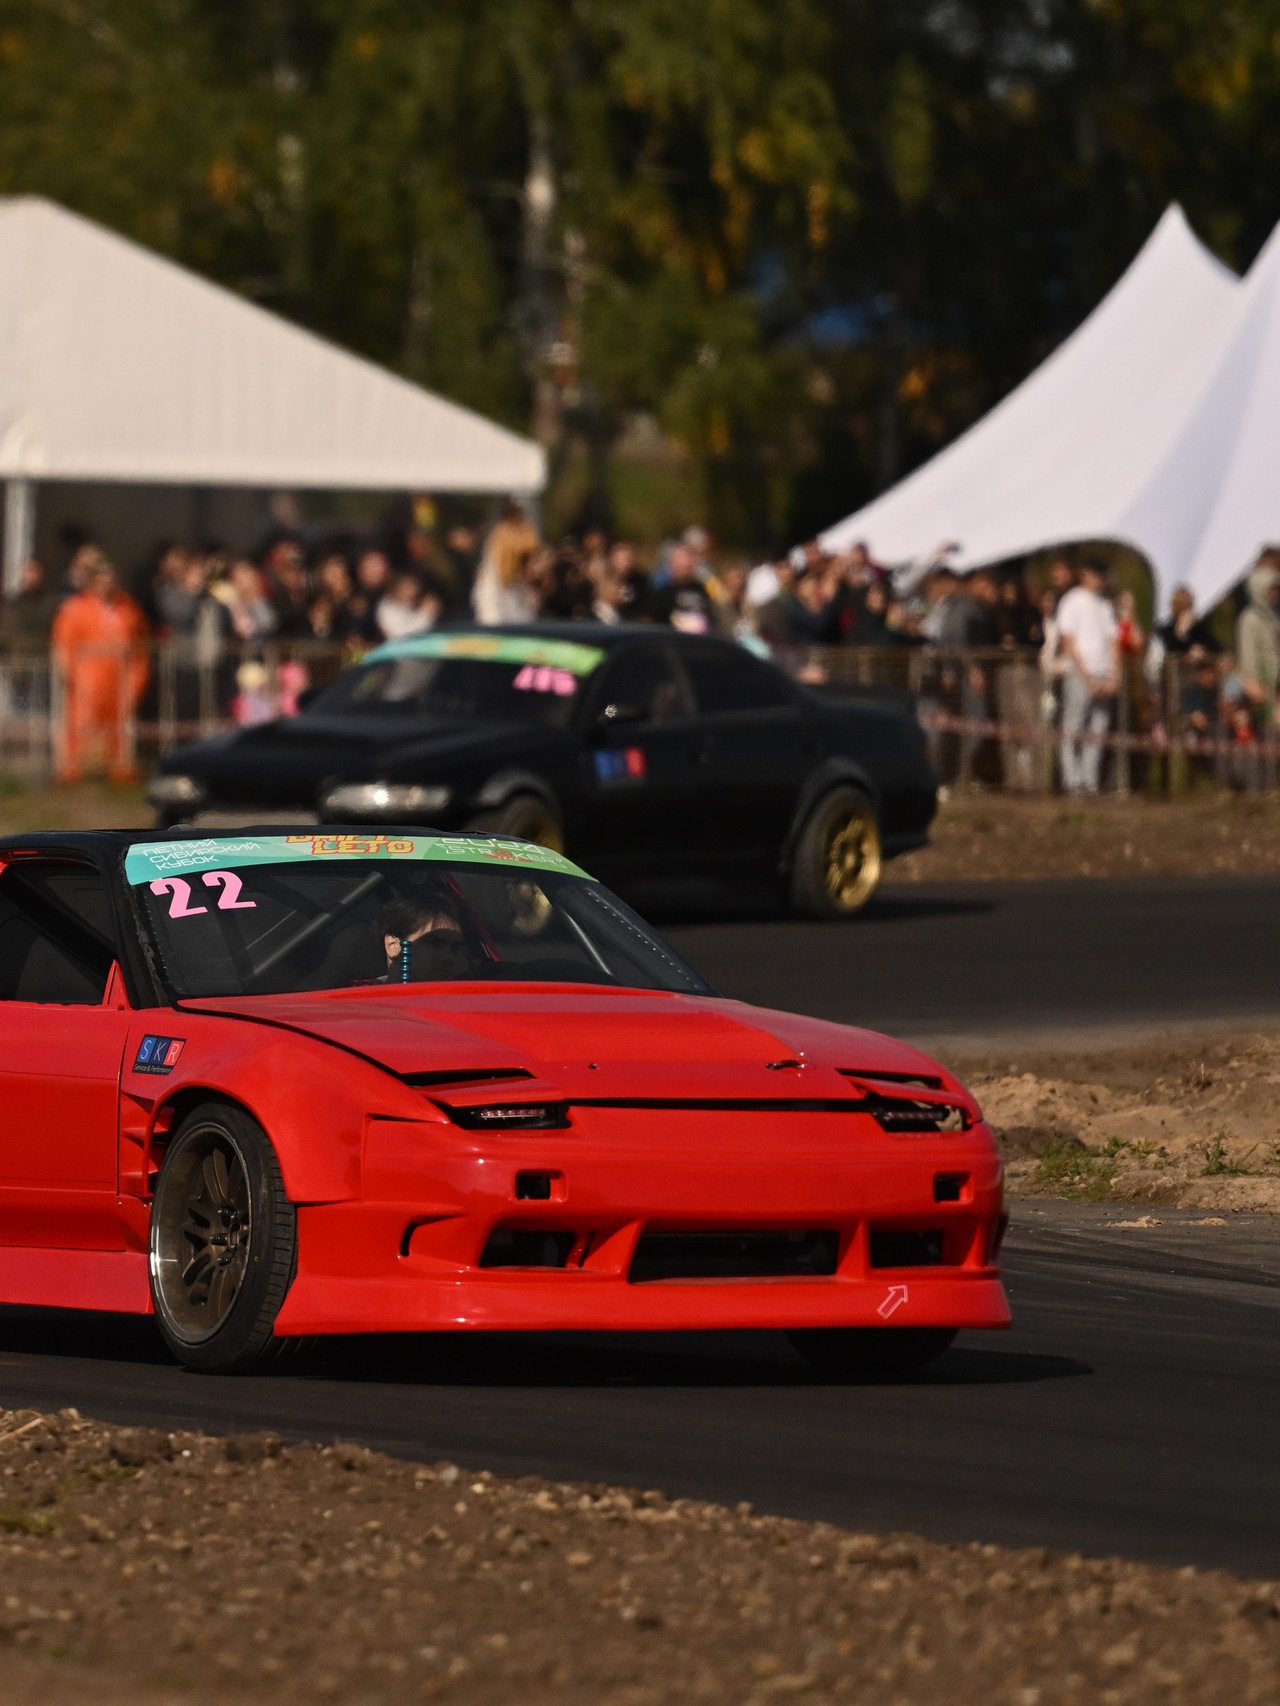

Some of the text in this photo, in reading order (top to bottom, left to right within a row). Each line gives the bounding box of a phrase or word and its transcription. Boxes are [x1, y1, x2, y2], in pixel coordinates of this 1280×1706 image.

[142, 839, 218, 857] ЛЕТНИЙ
[149, 842, 261, 863] СИБИРСКИЙ
[311, 840, 414, 854] LETO
[155, 855, 219, 870] КУБОК
[150, 871, 257, 919] 22
[140, 1040, 180, 1063] SKR
